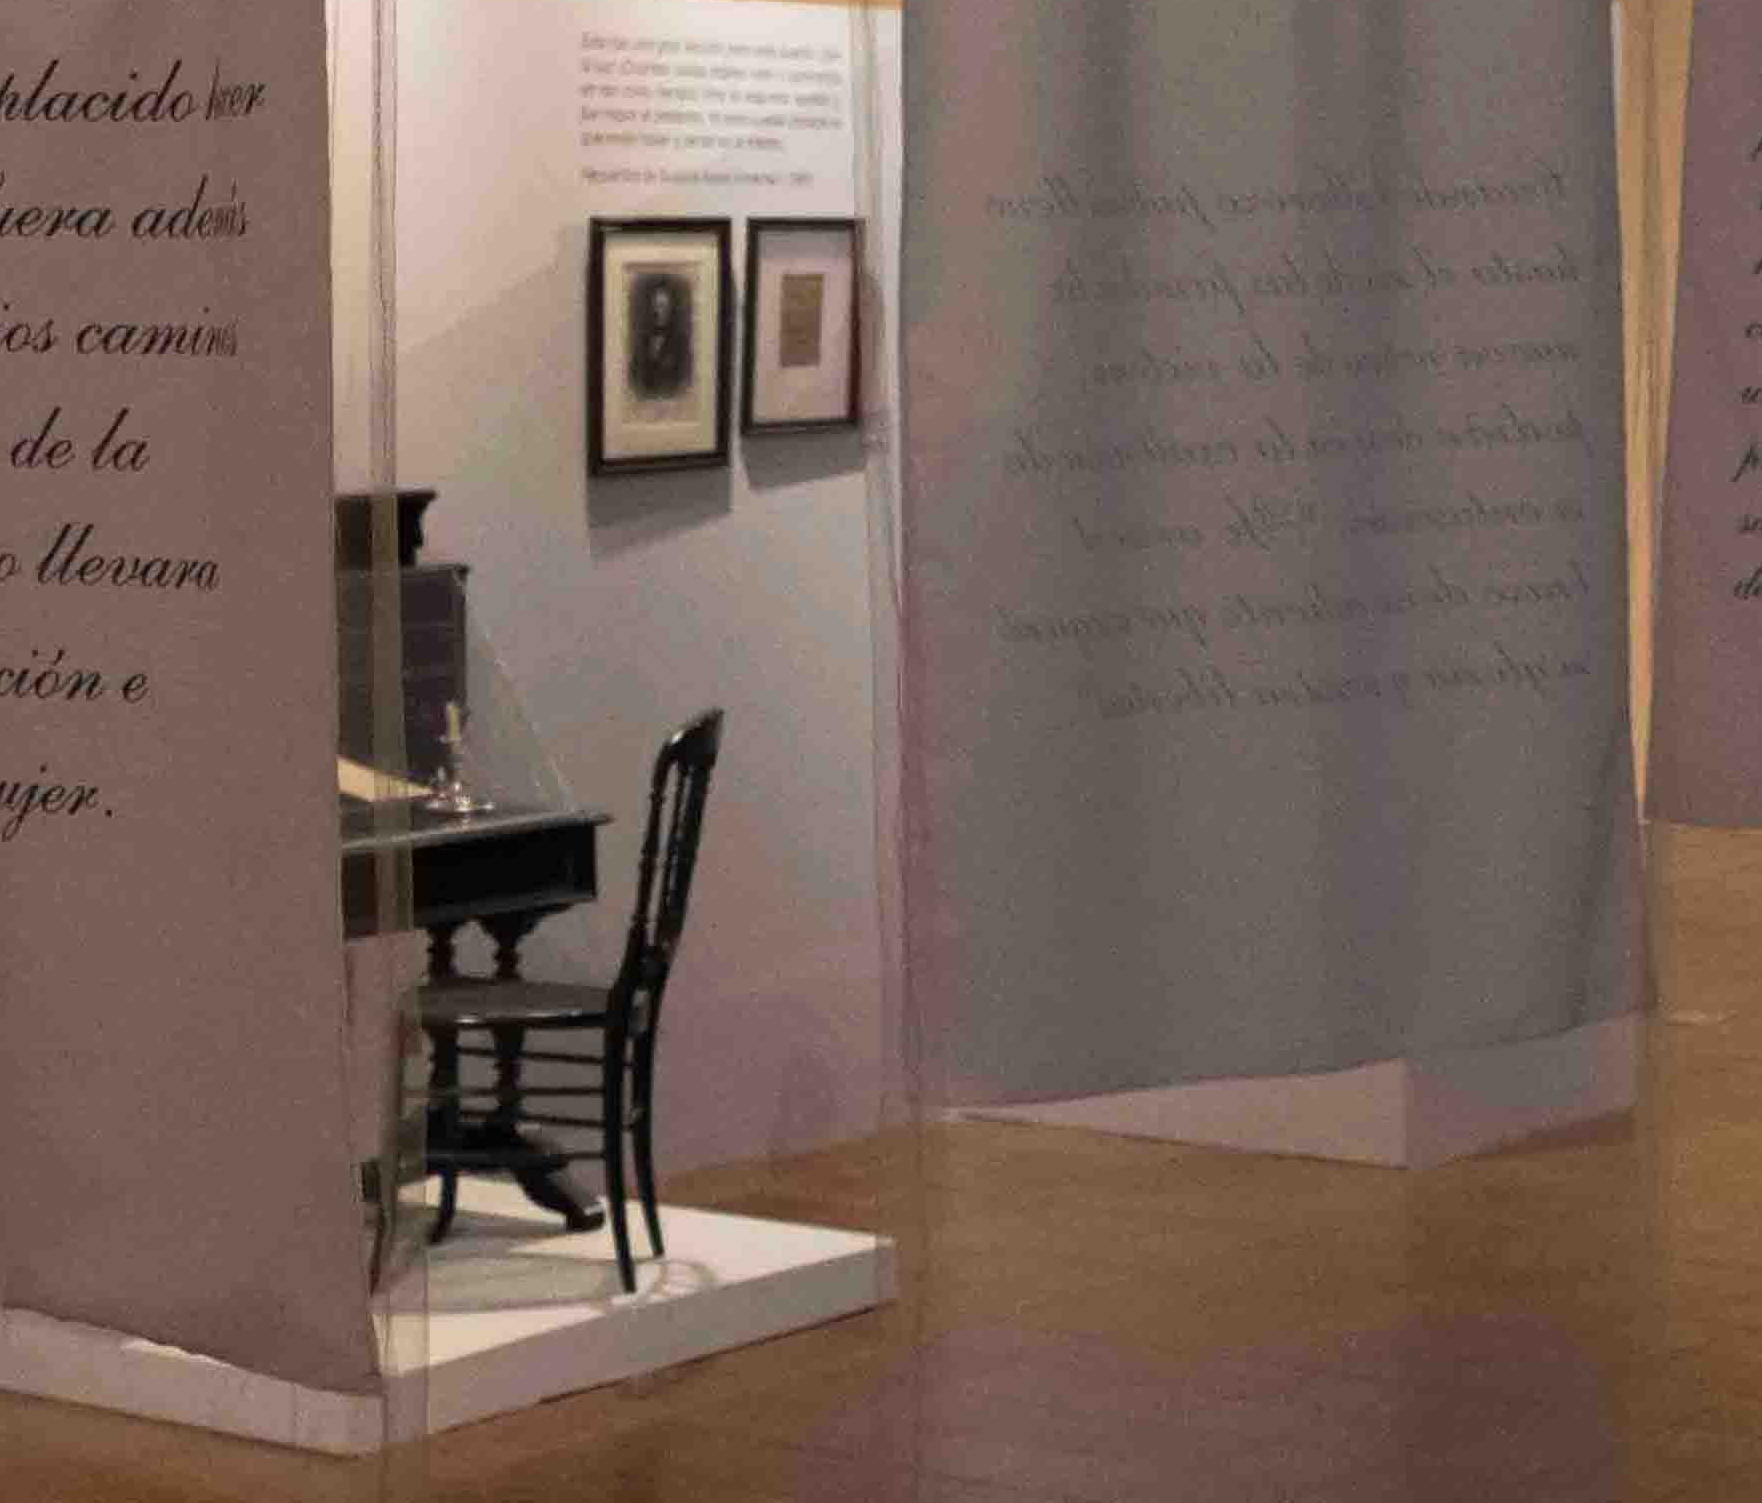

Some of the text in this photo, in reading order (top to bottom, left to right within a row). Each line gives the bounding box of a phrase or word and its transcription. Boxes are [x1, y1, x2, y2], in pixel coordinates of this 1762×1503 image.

[10, 406, 78, 471] de
[91, 407, 152, 473] la
[36, 520, 223, 591] llevara
[122, 670, 151, 704] e
